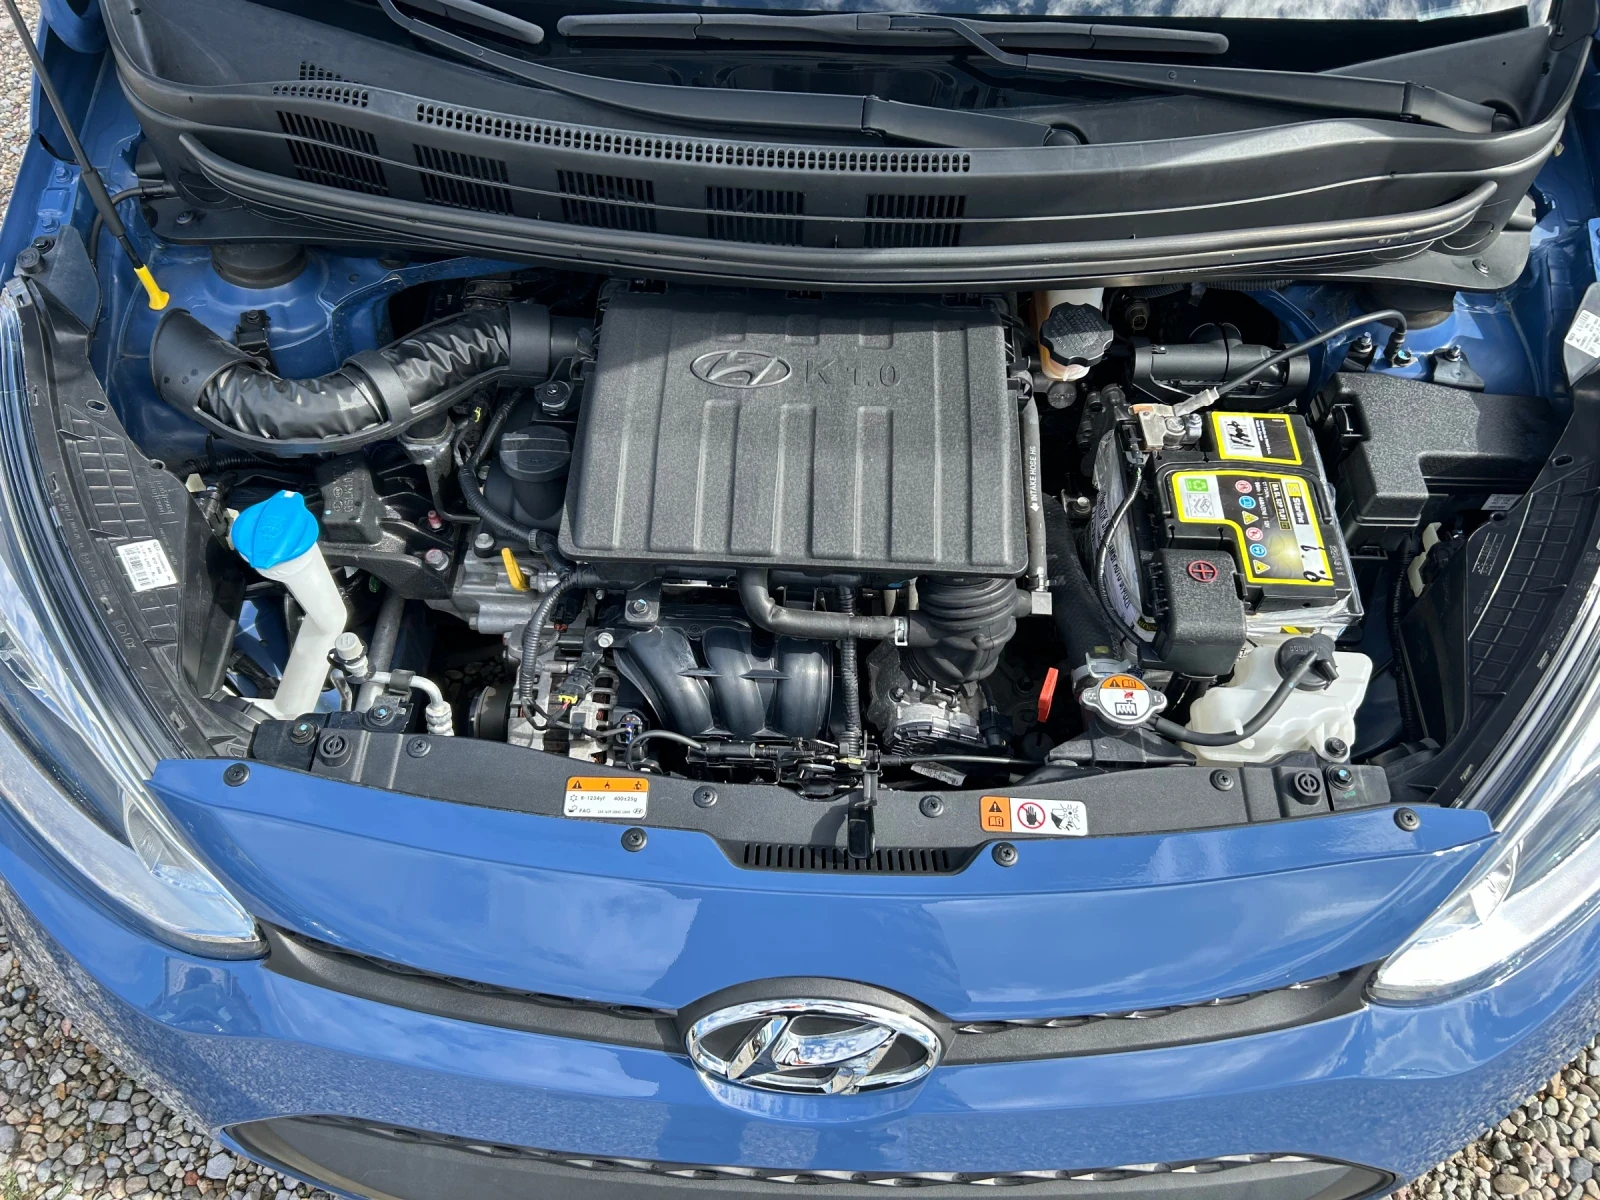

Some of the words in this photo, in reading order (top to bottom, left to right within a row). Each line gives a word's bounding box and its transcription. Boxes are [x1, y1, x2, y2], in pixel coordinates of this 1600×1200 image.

[1029, 456, 1037, 475] HOSE
[1029, 475, 1038, 502] INTAKE
[1292, 497, 1305, 524] Starline
